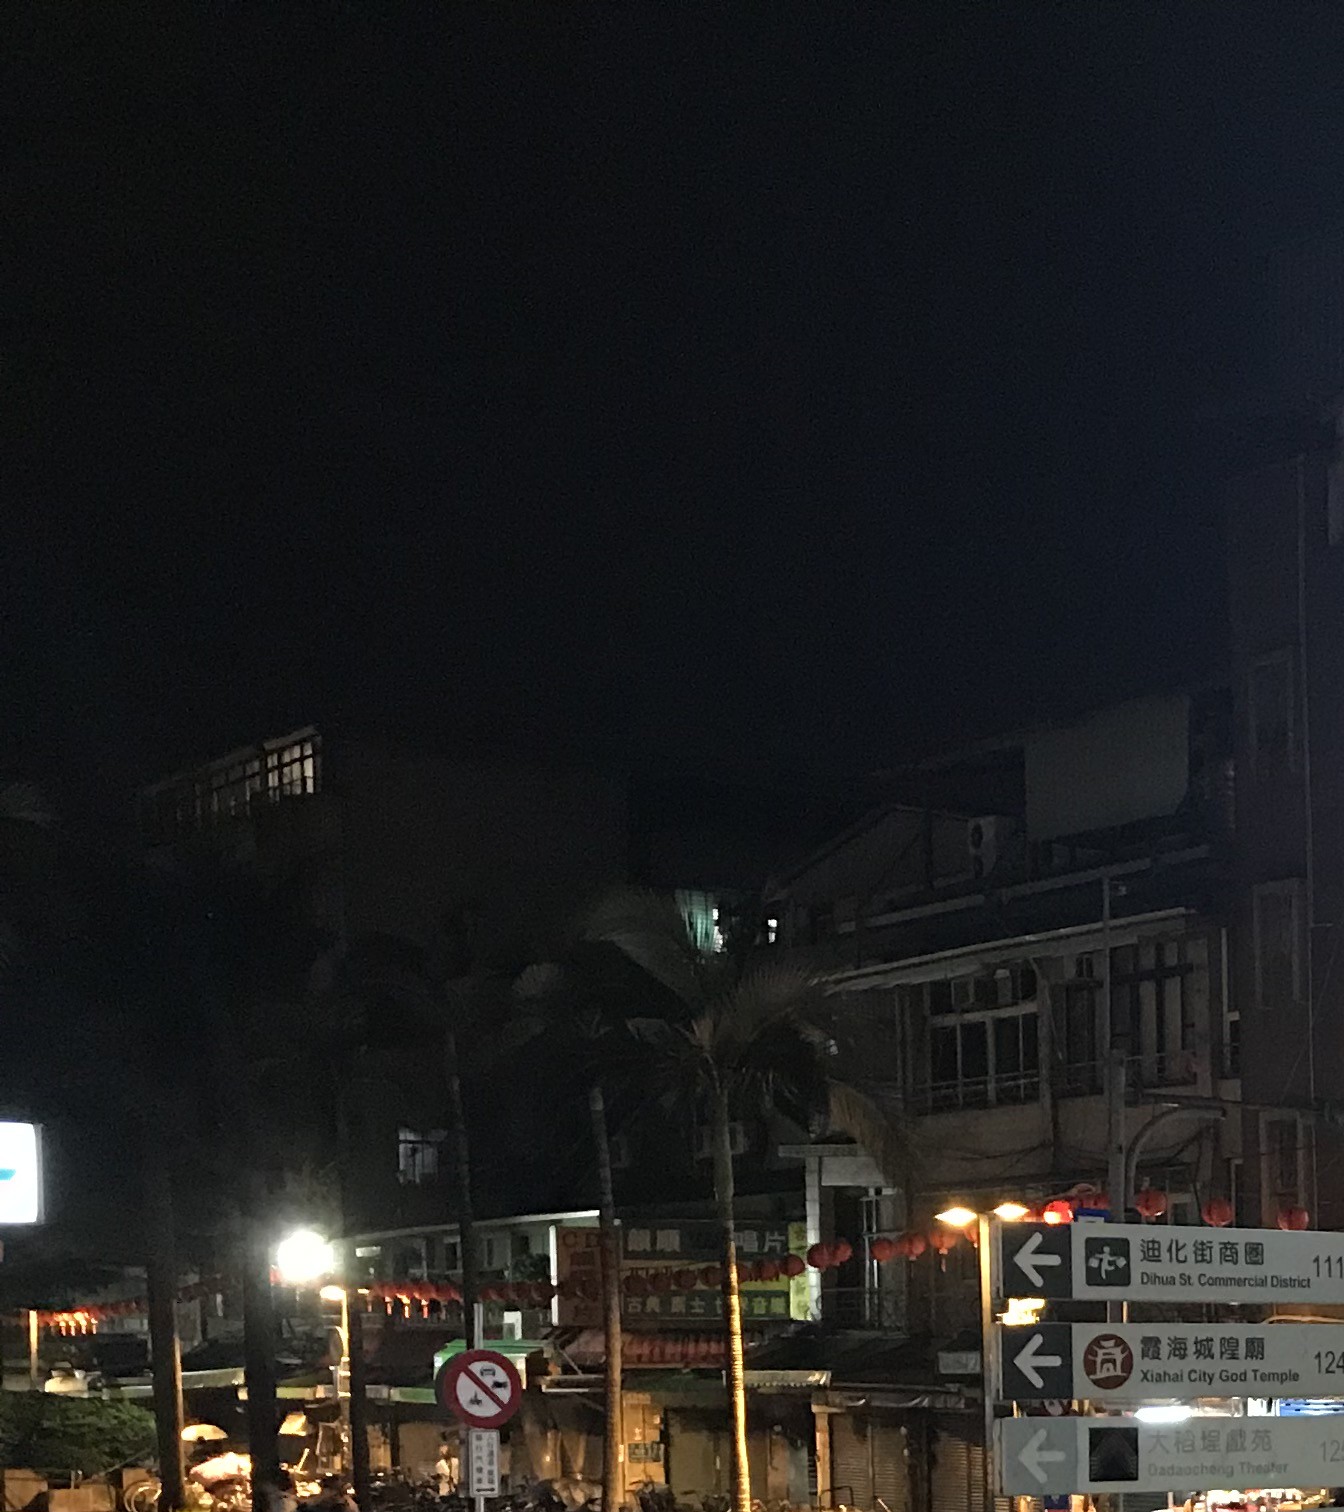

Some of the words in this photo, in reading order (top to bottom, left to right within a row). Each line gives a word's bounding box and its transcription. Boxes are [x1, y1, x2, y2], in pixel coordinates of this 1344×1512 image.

[1140, 1239, 1264, 1265] 迪化街商圈
[1141, 1272, 1175, 1286] Dihua
[1179, 1273, 1193, 1287] St.
[1198, 1274, 1267, 1288] Commercial
[1271, 1275, 1310, 1288] District
[1140, 1337, 1264, 1361] 霞海城隍廟
[1141, 1369, 1183, 1383] Xiahai
[1188, 1369, 1215, 1385] City
[1219, 1369, 1247, 1382] God
[1252, 1369, 1299, 1385] Temple
[1148, 1462, 1234, 1478] Dadaocheng
